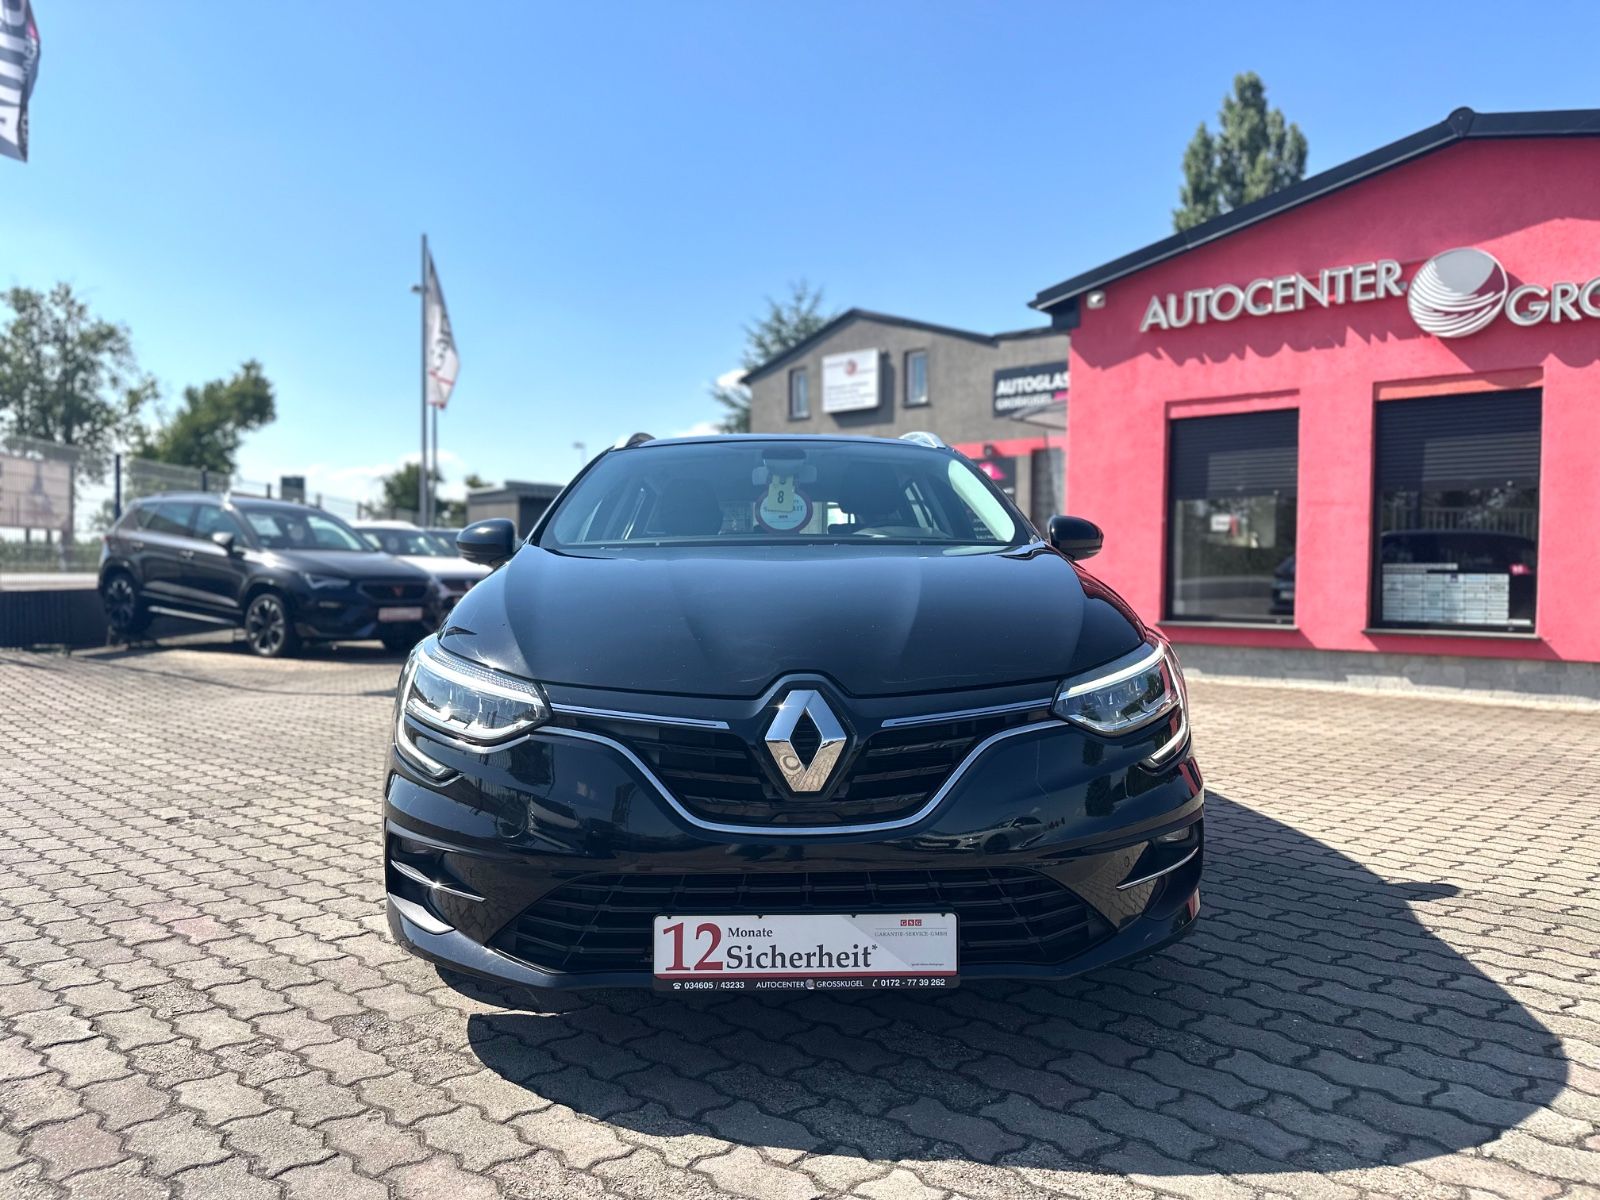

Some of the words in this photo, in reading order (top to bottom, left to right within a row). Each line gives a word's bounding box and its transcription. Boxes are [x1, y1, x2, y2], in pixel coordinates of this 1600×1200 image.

[1140, 259, 1404, 333] AUTOCENTER
[777, 490, 785, 504] 8
[727, 927, 773, 938] Monate
[663, 922, 724, 971] 12
[684, 981, 714, 990] 034605
[720, 981, 745, 989] 43233
[755, 981, 805, 989] AUTOCENTER
[816, 980, 864, 988] GROSSKUGEL
[880, 979, 900, 987] 0172
[907, 979, 917, 987] 77
